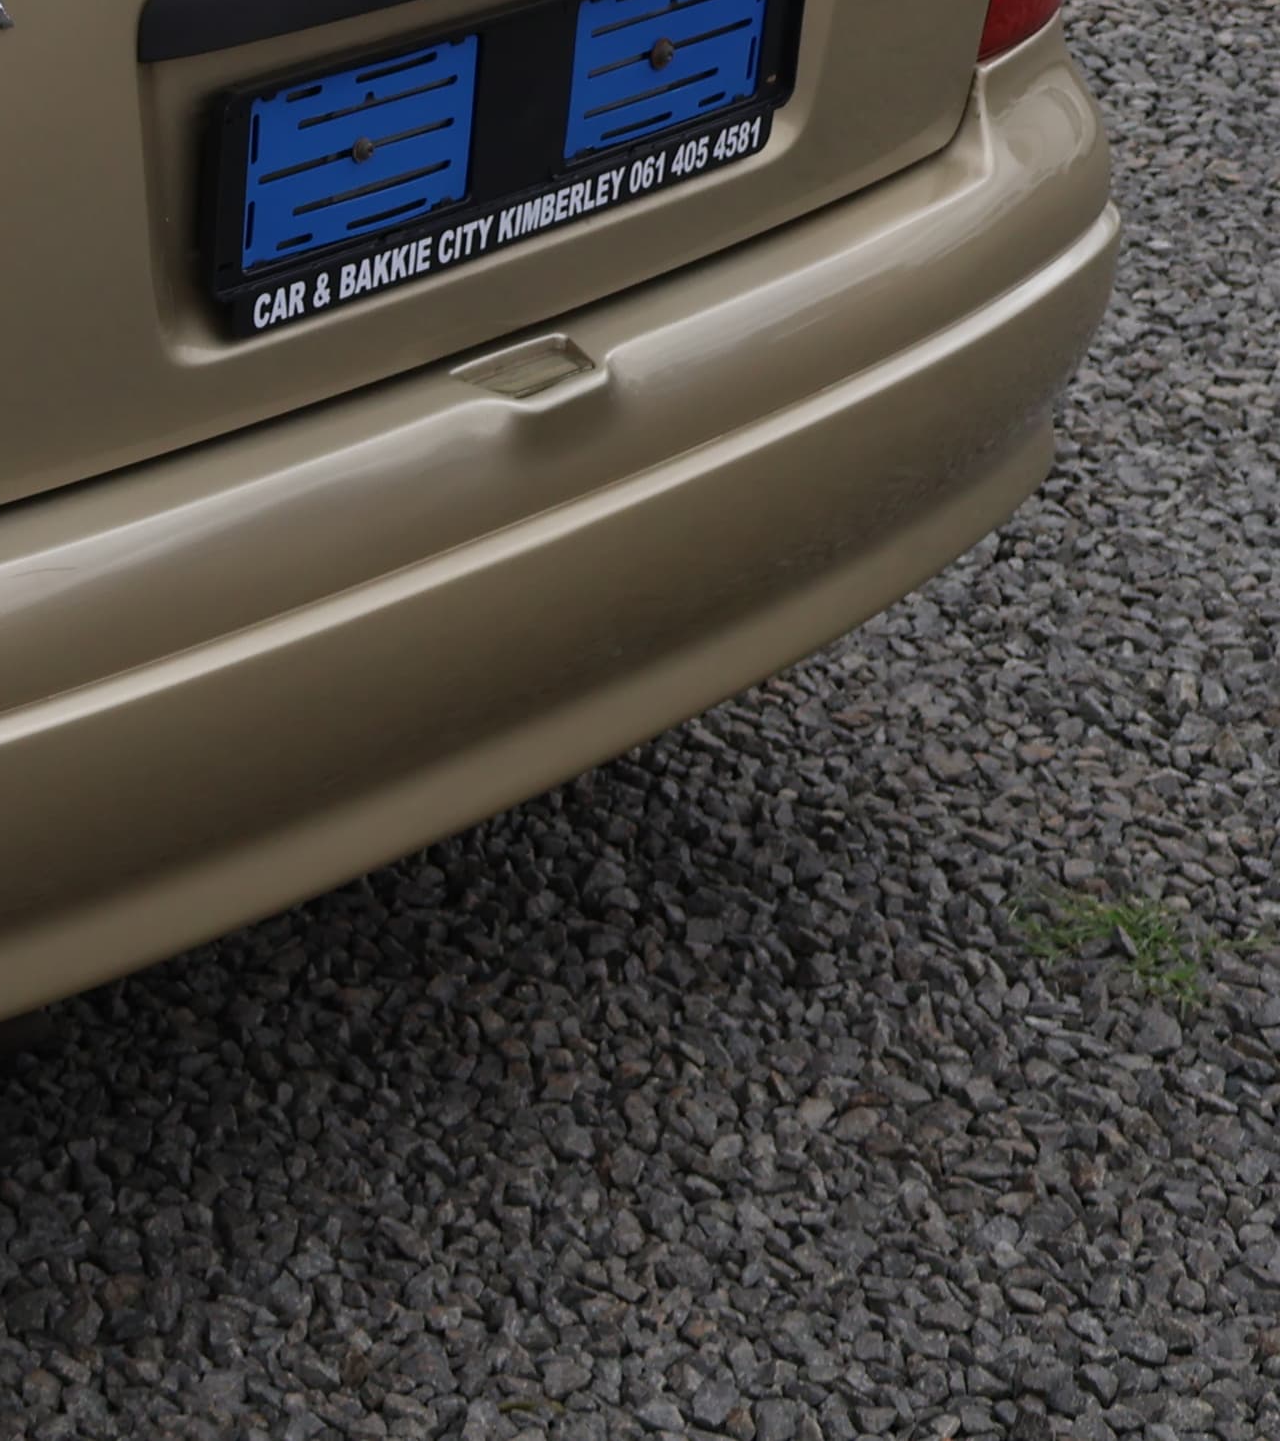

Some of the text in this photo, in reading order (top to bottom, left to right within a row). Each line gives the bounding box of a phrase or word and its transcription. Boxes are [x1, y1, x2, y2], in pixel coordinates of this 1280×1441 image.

[252, 115, 762, 329] CAR & BAKKIE CITY KIMBERLEY 061 405 4581
